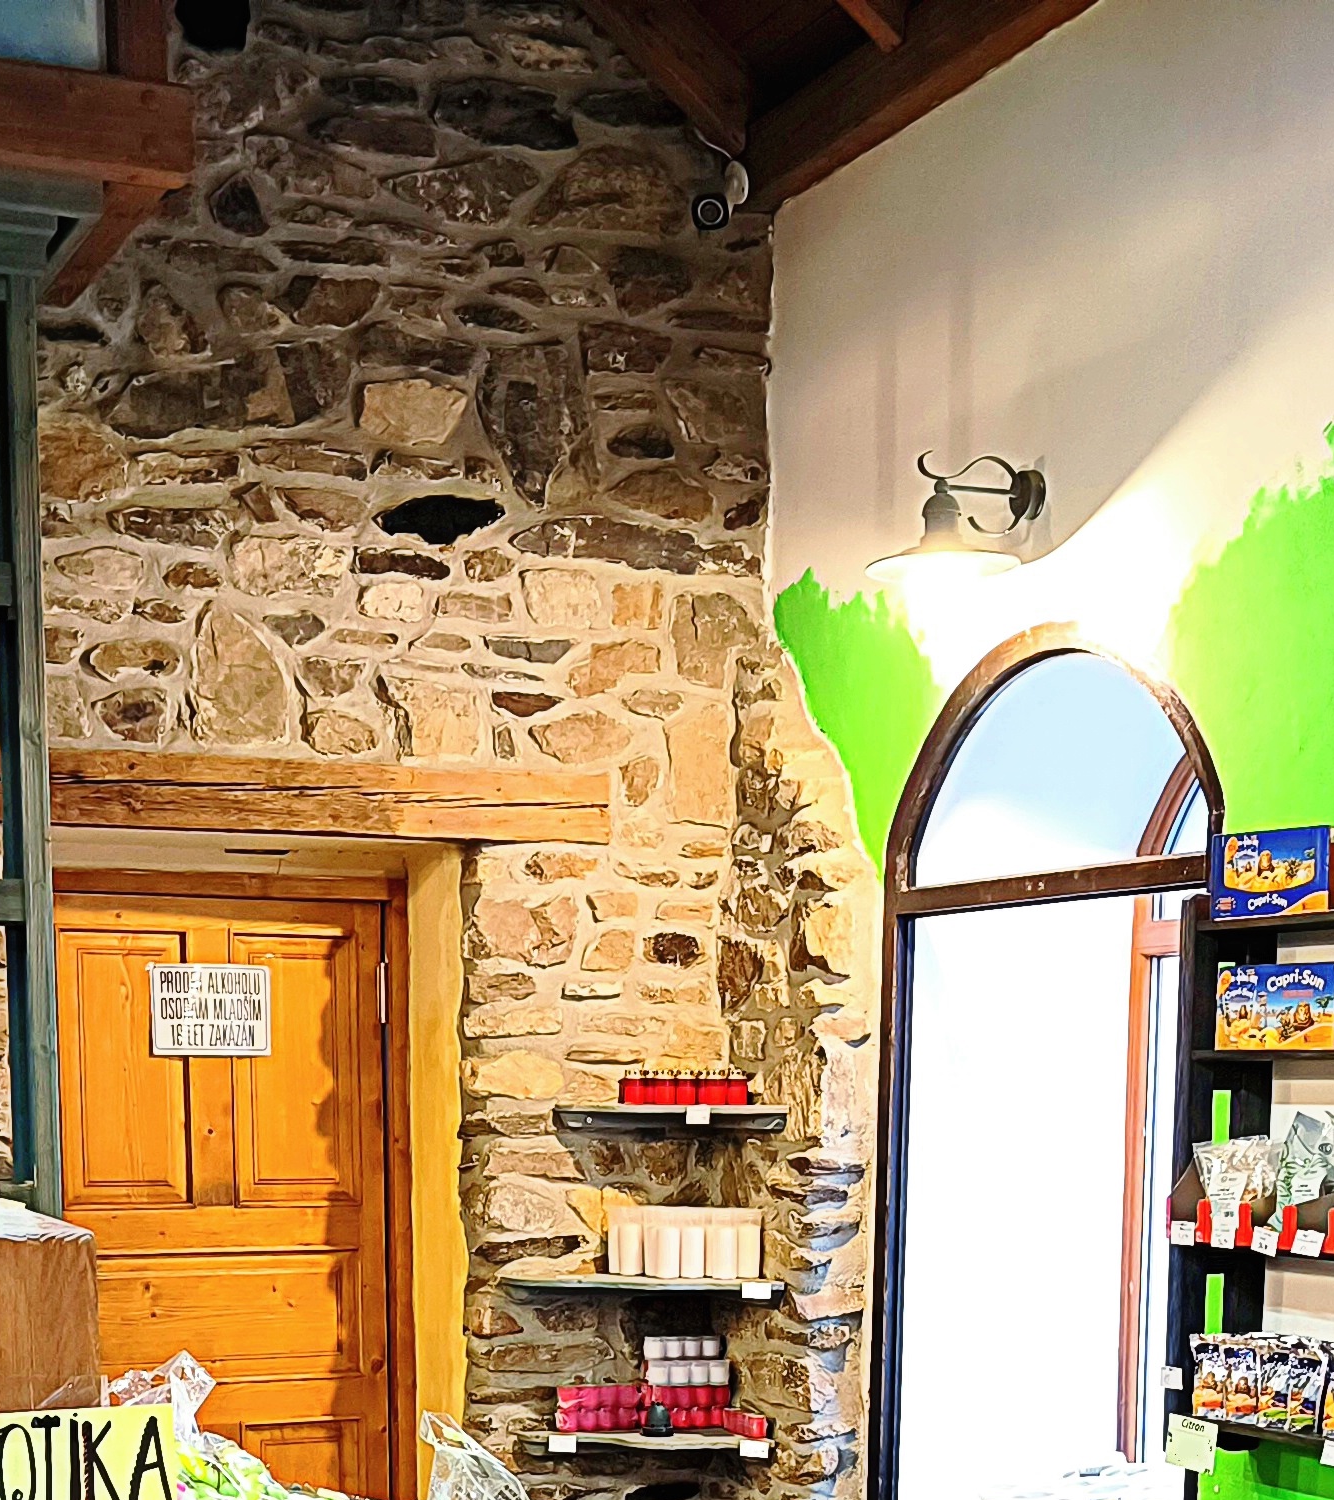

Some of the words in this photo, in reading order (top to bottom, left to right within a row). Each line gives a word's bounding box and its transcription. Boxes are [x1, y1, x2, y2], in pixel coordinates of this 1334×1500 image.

[208, 972, 261, 996] ALKOHOLU
[1266, 968, 1325, 993] Capri-Sun
[209, 1021, 255, 1047] ZAKÁZÁN
[1181, 1418, 1205, 1433] Citron
